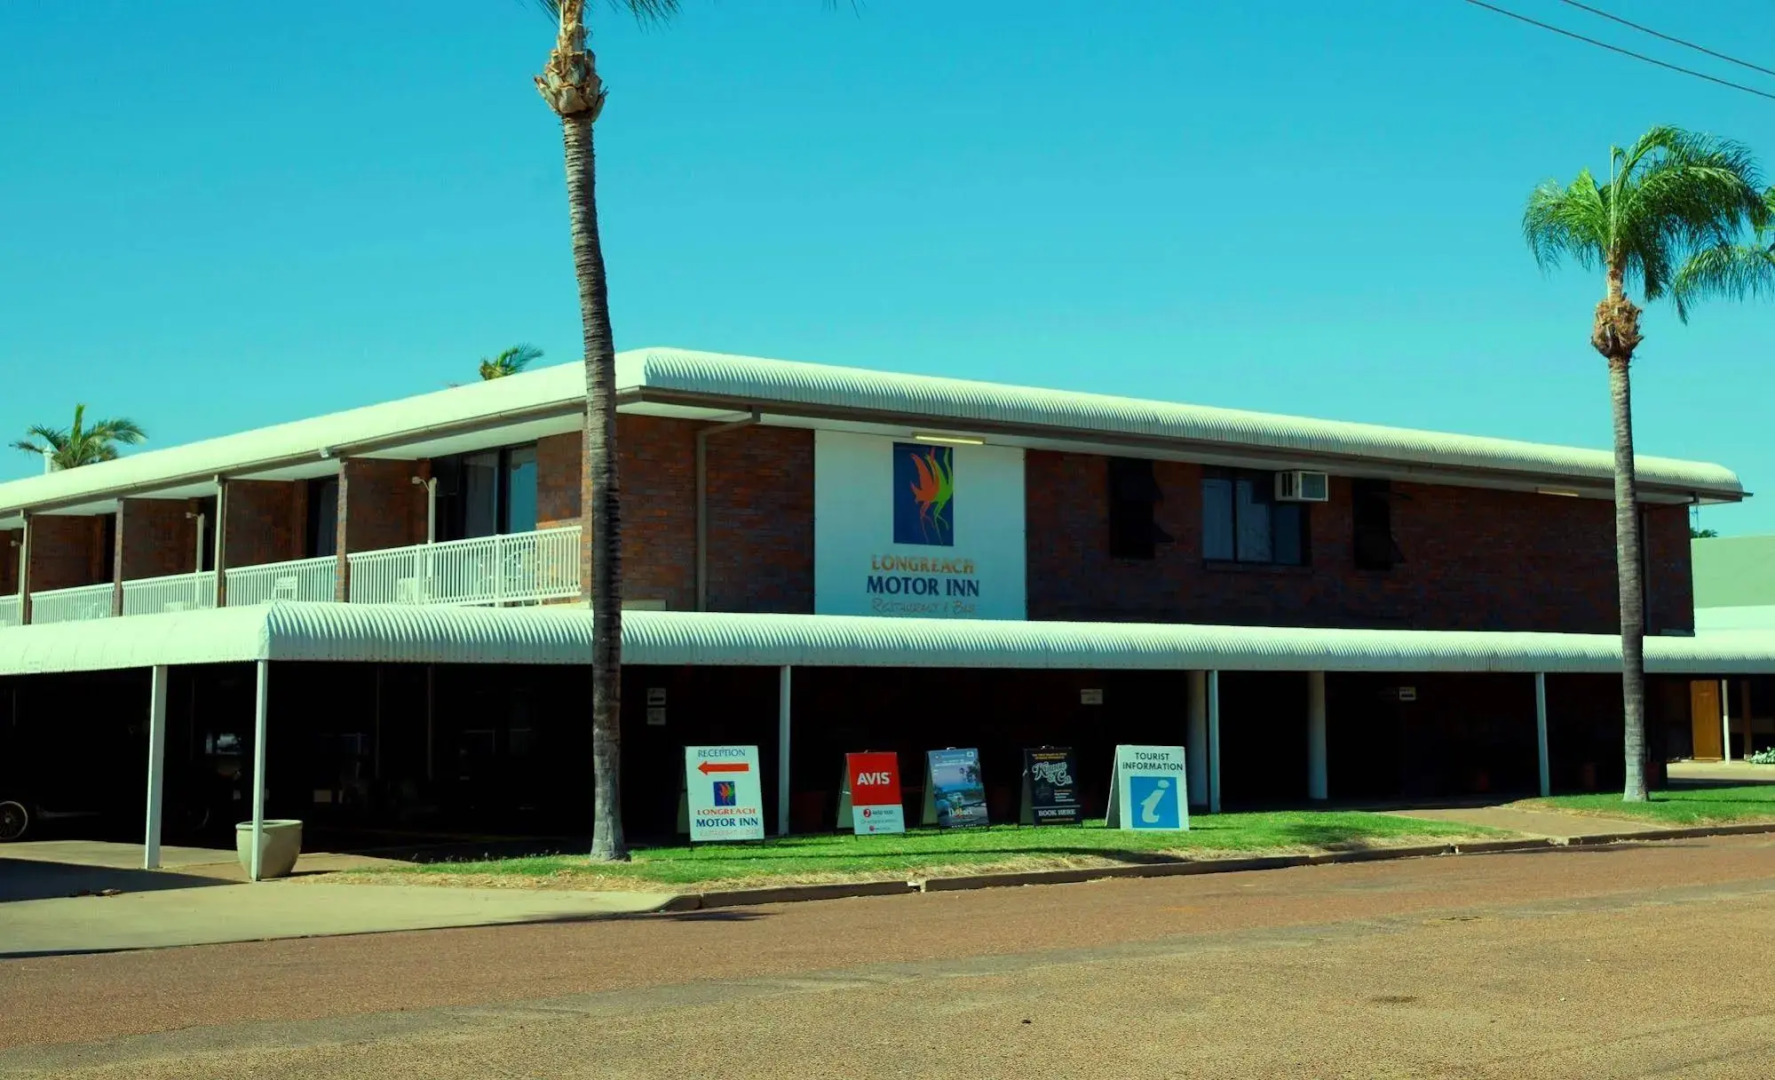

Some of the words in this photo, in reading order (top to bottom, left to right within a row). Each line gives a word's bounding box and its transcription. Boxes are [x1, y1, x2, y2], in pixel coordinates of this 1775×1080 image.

[871, 554, 975, 574] LONGREACH
[867, 576, 940, 596] MOTOR
[946, 578, 980, 597] INN
[697, 748, 746, 757] RECEPTION
[1135, 752, 1170, 760] TOURIST
[1122, 762, 1183, 771] INFORMATION
[856, 772, 890, 785] AVIS
[696, 818, 736, 827] MOTOR
[739, 817, 758, 826] INN
